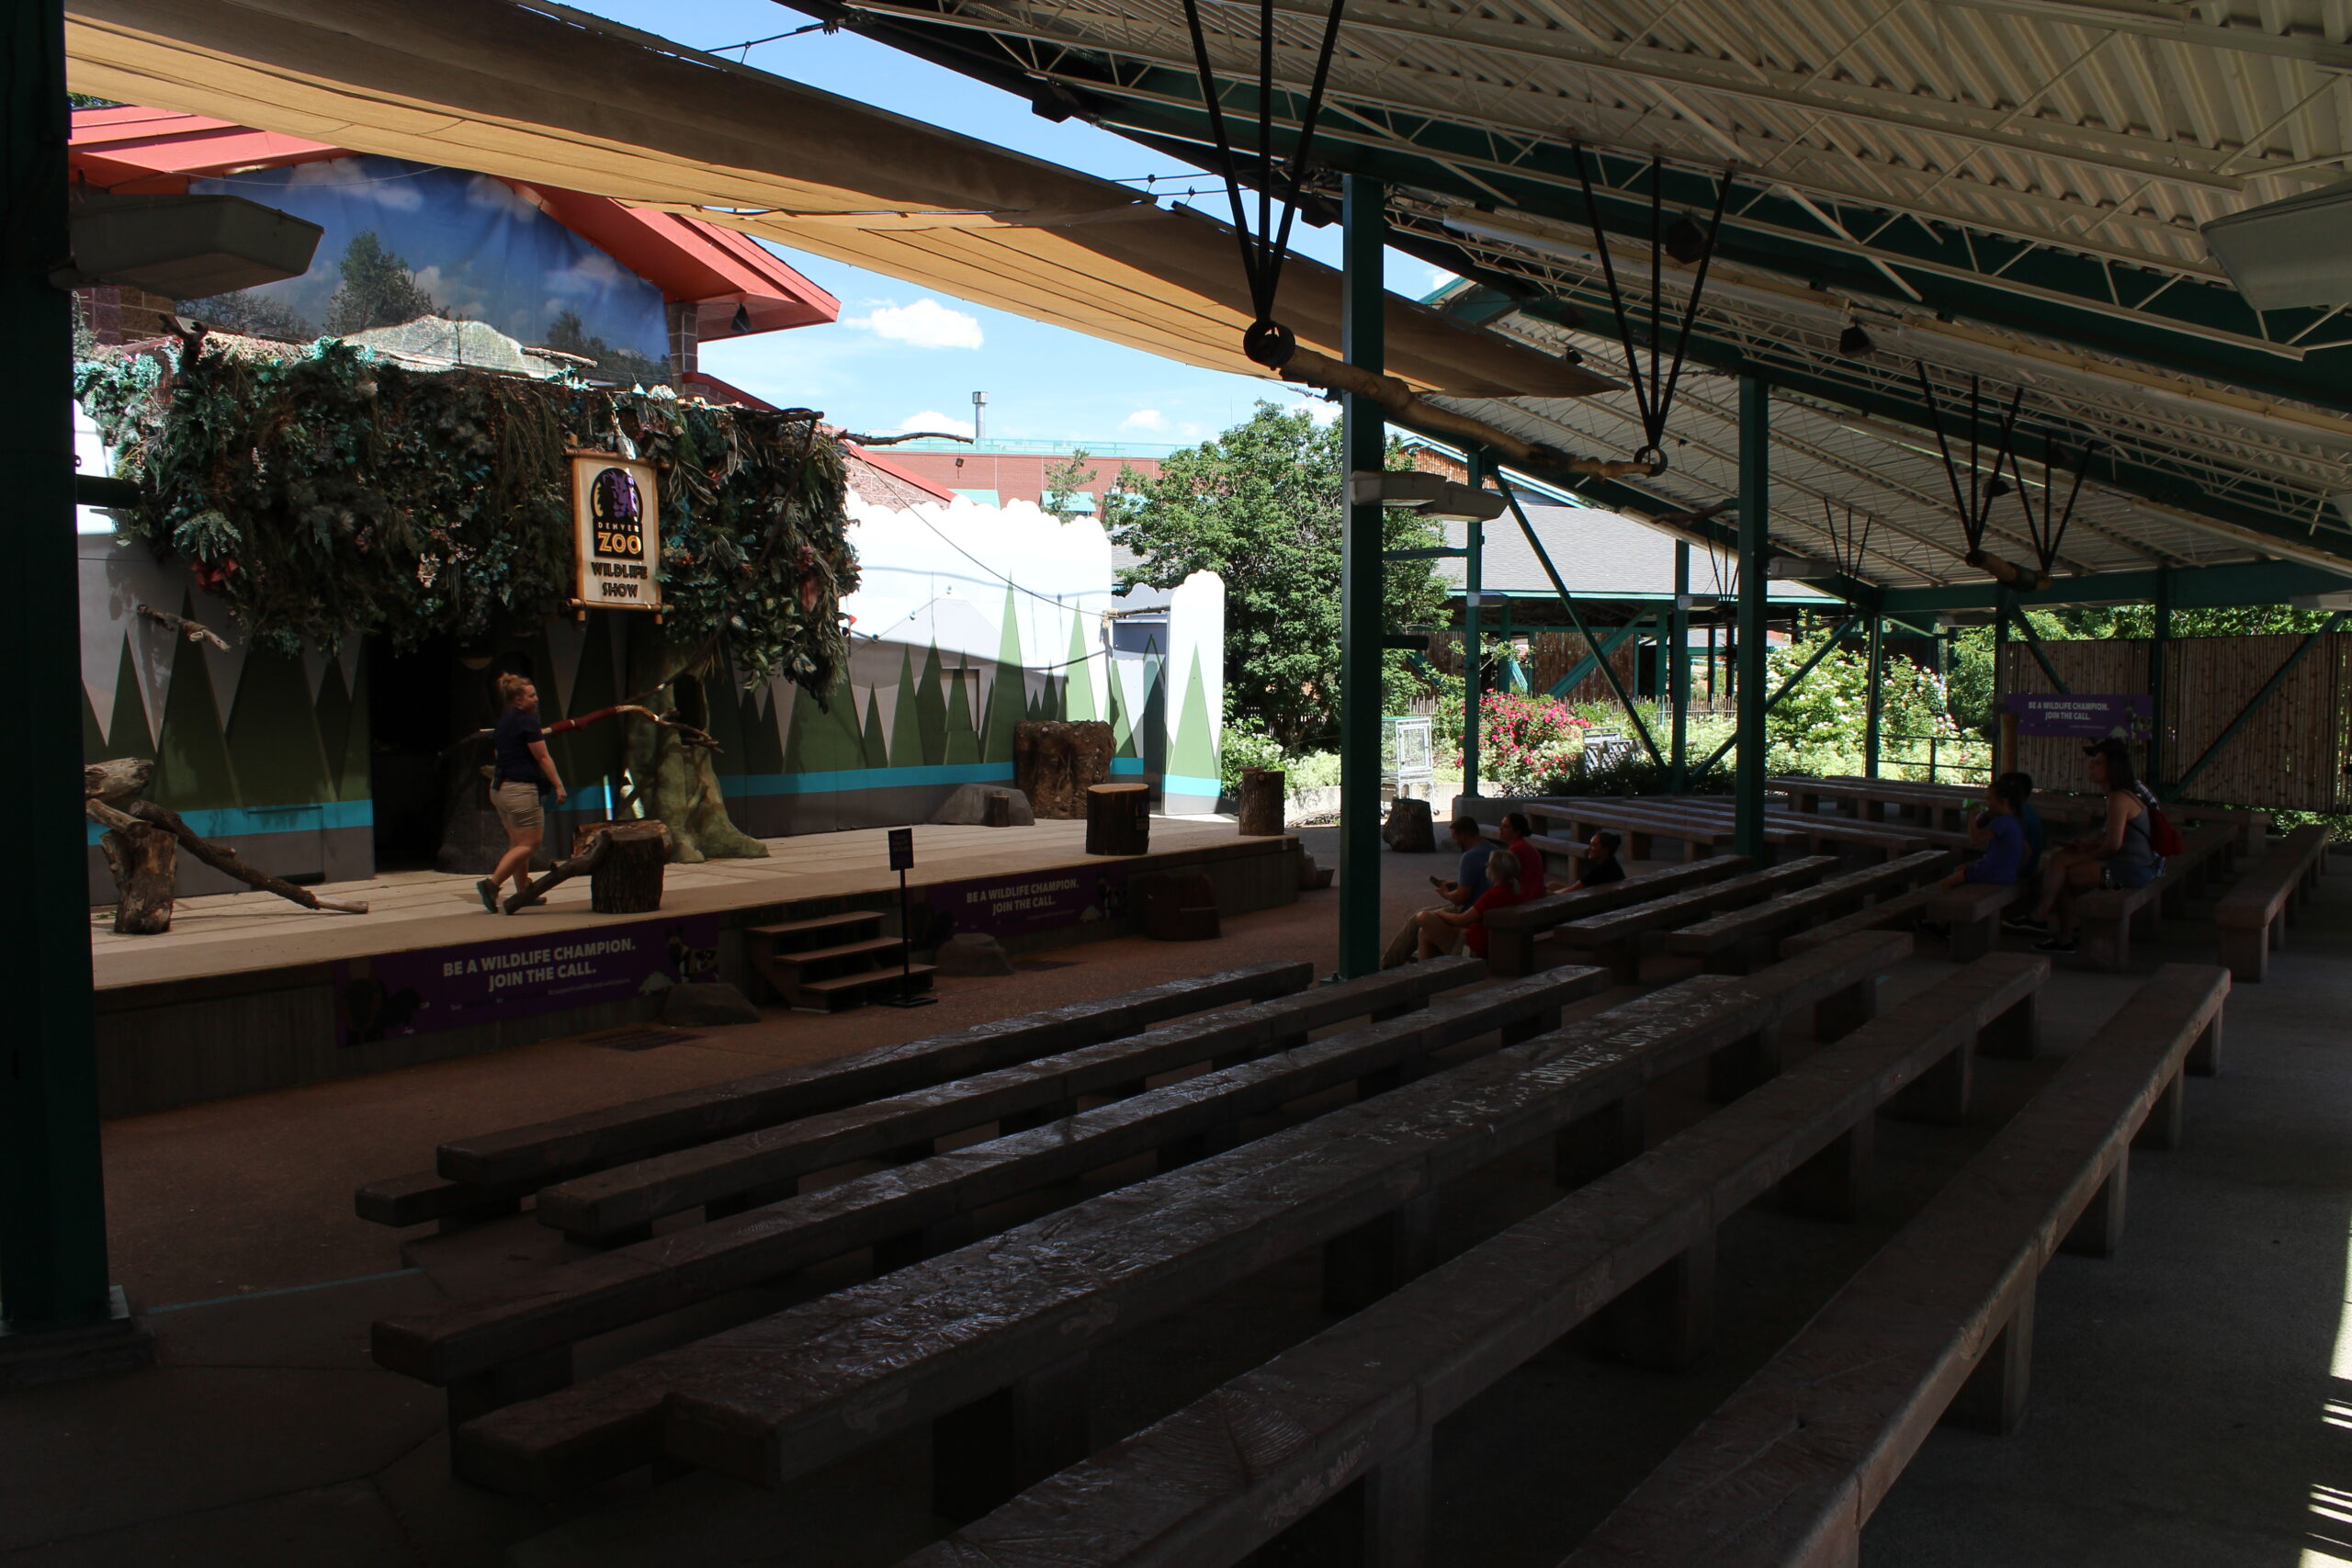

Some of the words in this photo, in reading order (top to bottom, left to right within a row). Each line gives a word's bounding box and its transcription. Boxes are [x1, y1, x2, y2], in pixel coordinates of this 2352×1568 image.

[597, 521, 639, 532] DENVER
[597, 532, 642, 555] ZOO
[591, 562, 648, 579] WILDLIFE
[602, 581, 639, 598] SHOW
[2043, 702, 2072, 710] WILDLIFE
[2073, 703, 2109, 711] CHAMPION.
[2045, 712, 2060, 720] JOIN
[2060, 712, 2073, 720] THE
[2074, 712, 2092, 720] CALL.
[966, 892, 978, 904] BE
[979, 890, 988, 902] A
[989, 885, 1030, 900] WILDLIFE
[1031, 878, 1080, 895] CHAMPION.
[992, 900, 1013, 917] JOIN
[1014, 898, 1032, 910] THE
[1032, 895, 1057, 908] CALL.
[443, 960, 464, 977] BE
[466, 958, 478, 974] A
[481, 949, 551, 971] WILDLIFE
[553, 937, 637, 961] CHAMPION.
[488, 970, 523, 993] JOIN
[526, 966, 555, 983] THE
[557, 961, 597, 978] CALL.
